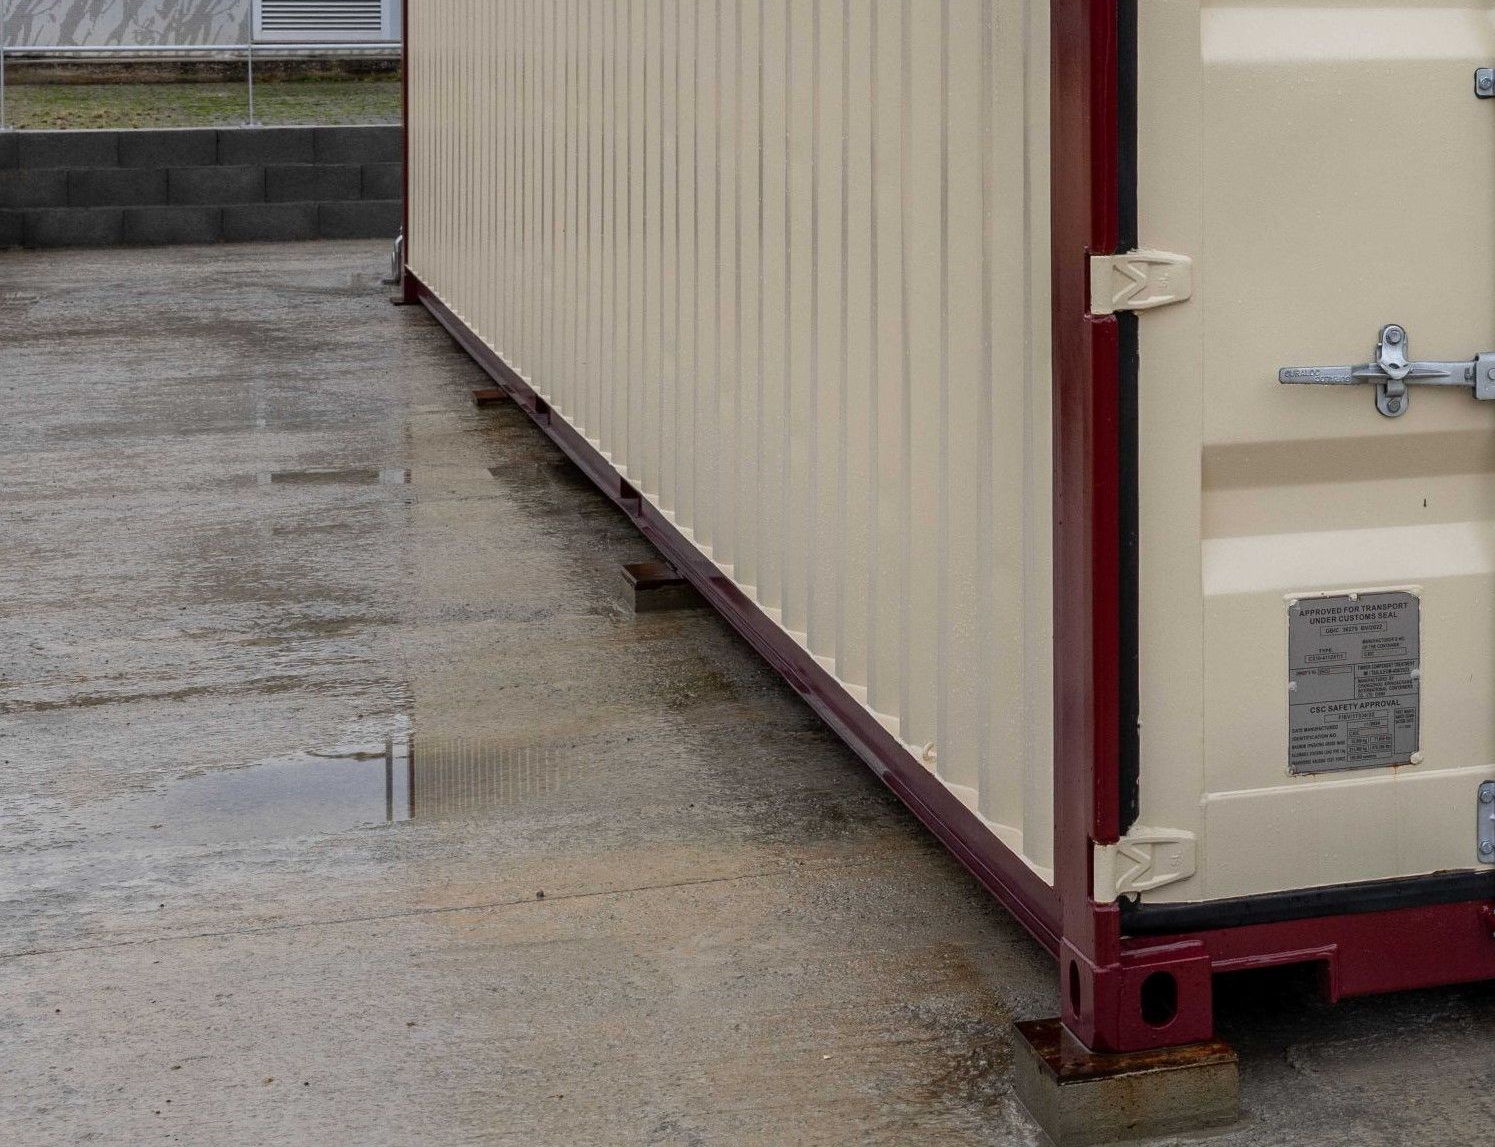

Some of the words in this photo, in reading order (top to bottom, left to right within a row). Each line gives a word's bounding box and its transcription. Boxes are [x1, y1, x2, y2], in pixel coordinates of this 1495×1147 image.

[1299, 607, 1342, 617] APPROVED
[1361, 602, 1408, 612] TRANSPORT
[1310, 616, 1337, 624] UNDER
[1338, 613, 1376, 622] CUSTOMS
[1328, 703, 1358, 712] SAFETY
[1360, 699, 1400, 709] APPROVAL
